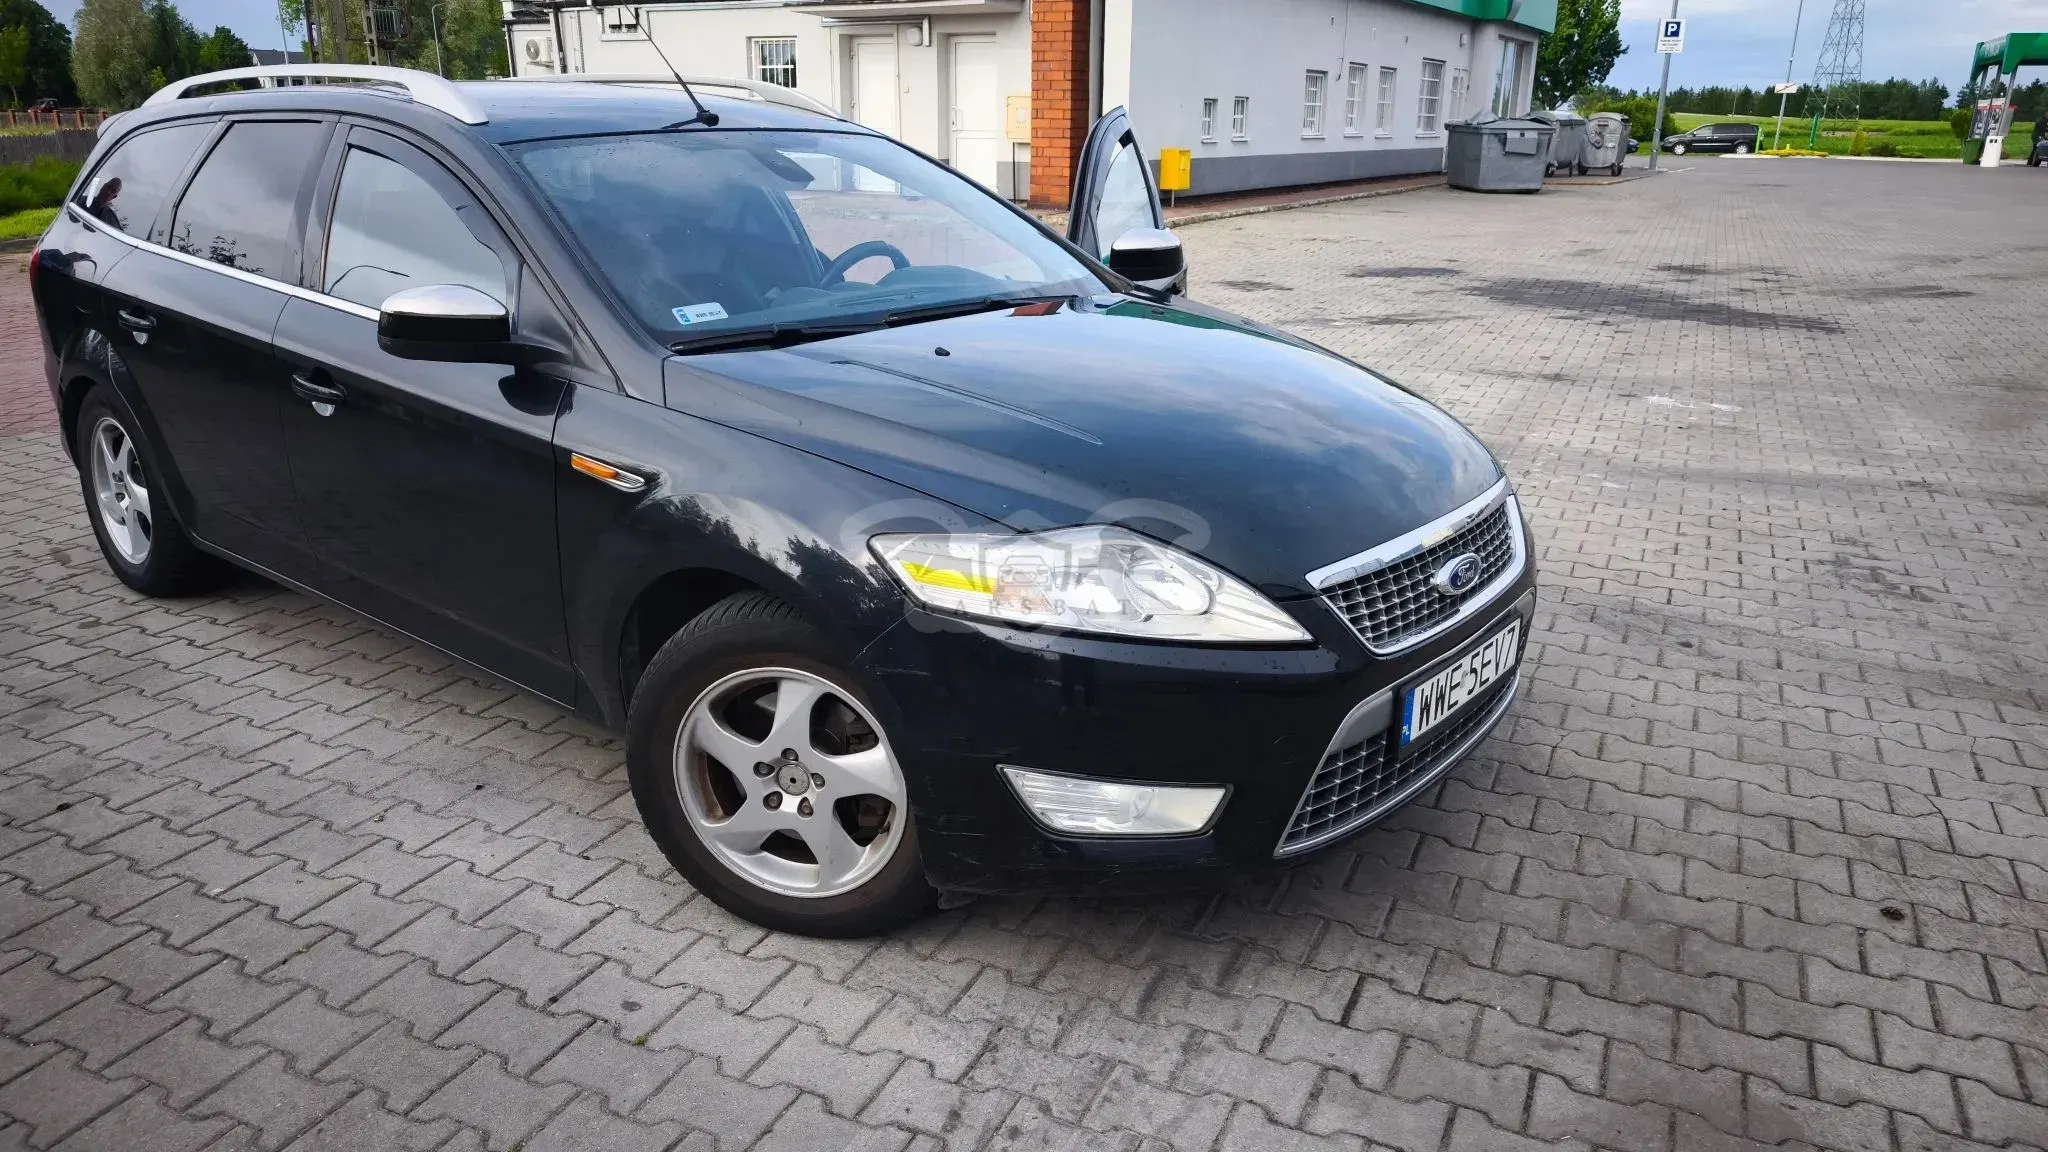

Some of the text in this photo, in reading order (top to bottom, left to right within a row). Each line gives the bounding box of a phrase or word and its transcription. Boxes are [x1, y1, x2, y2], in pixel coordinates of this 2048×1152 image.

[1667, 23, 1677, 36] P
[1457, 563, 1475, 586] Ford
[1418, 625, 1516, 731] WWE 5EV7
